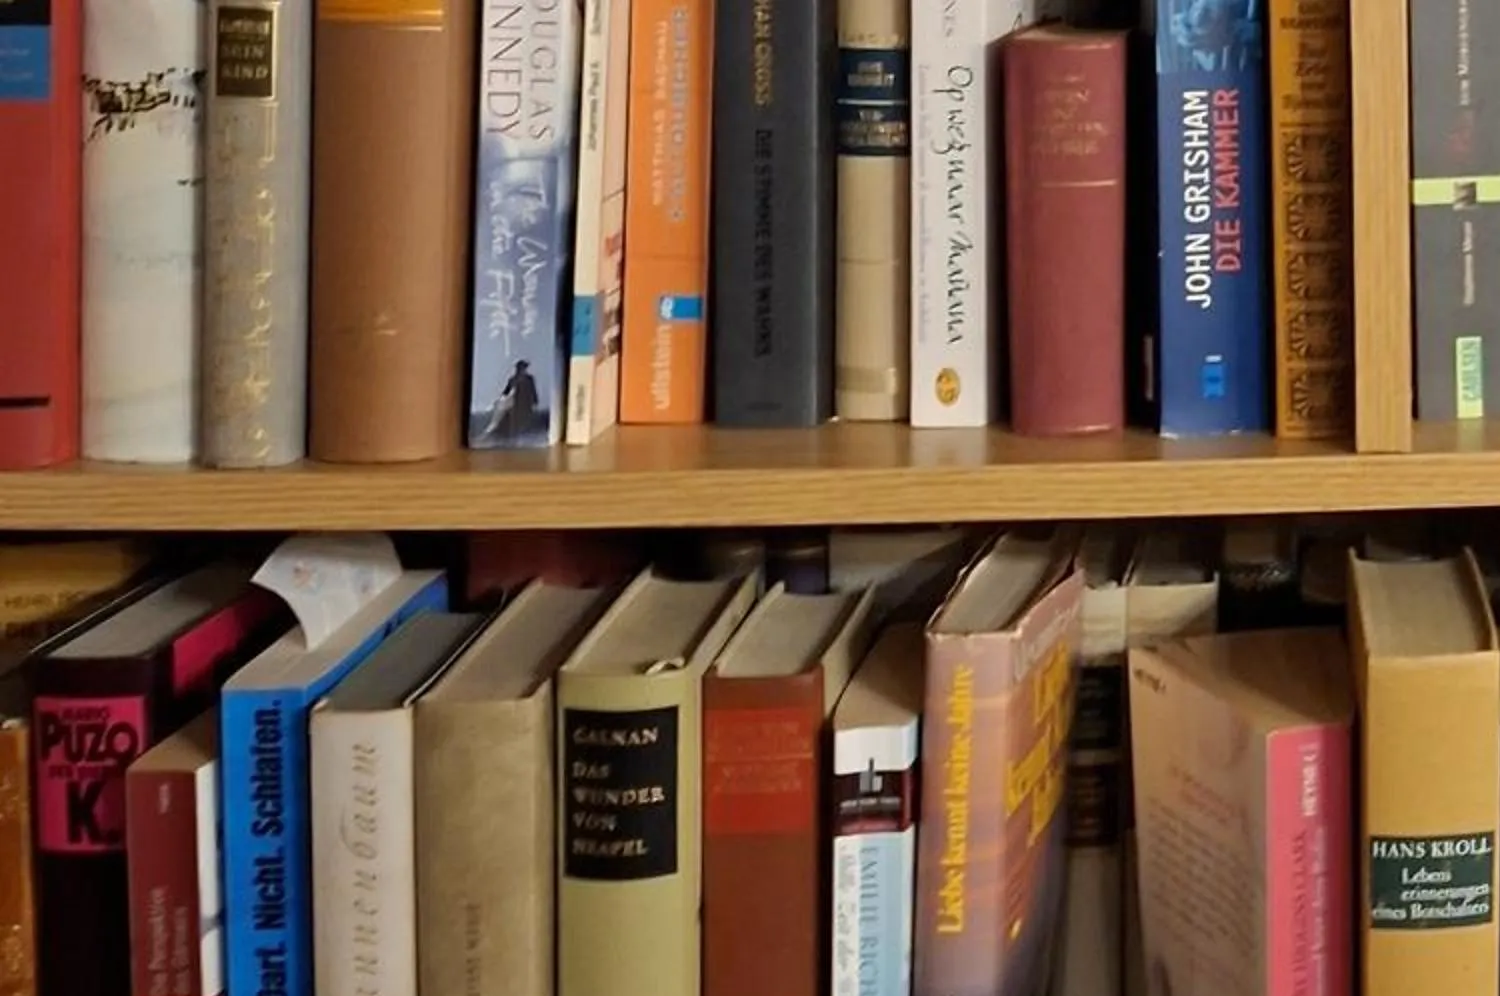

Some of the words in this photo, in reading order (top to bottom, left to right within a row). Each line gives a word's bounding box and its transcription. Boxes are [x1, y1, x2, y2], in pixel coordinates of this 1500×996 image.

[1183, 90, 1211, 223] GRISHAM
[1213, 88, 1241, 209] KAMMER
[1184, 233, 1212, 309] JOHN
[1214, 219, 1241, 272] DIE
[39, 711, 139, 764] PUZO
[250, 700, 284, 838] Schlafen.
[1302, 763, 1319, 816] HEYNE
[938, 796, 967, 866] kennt
[1372, 840, 1426, 859] HANS
[1431, 837, 1492, 858] KROLL
[253, 846, 286, 932] Nicht.
[935, 867, 965, 934] Liebe
[1402, 867, 1452, 884] Lebens
